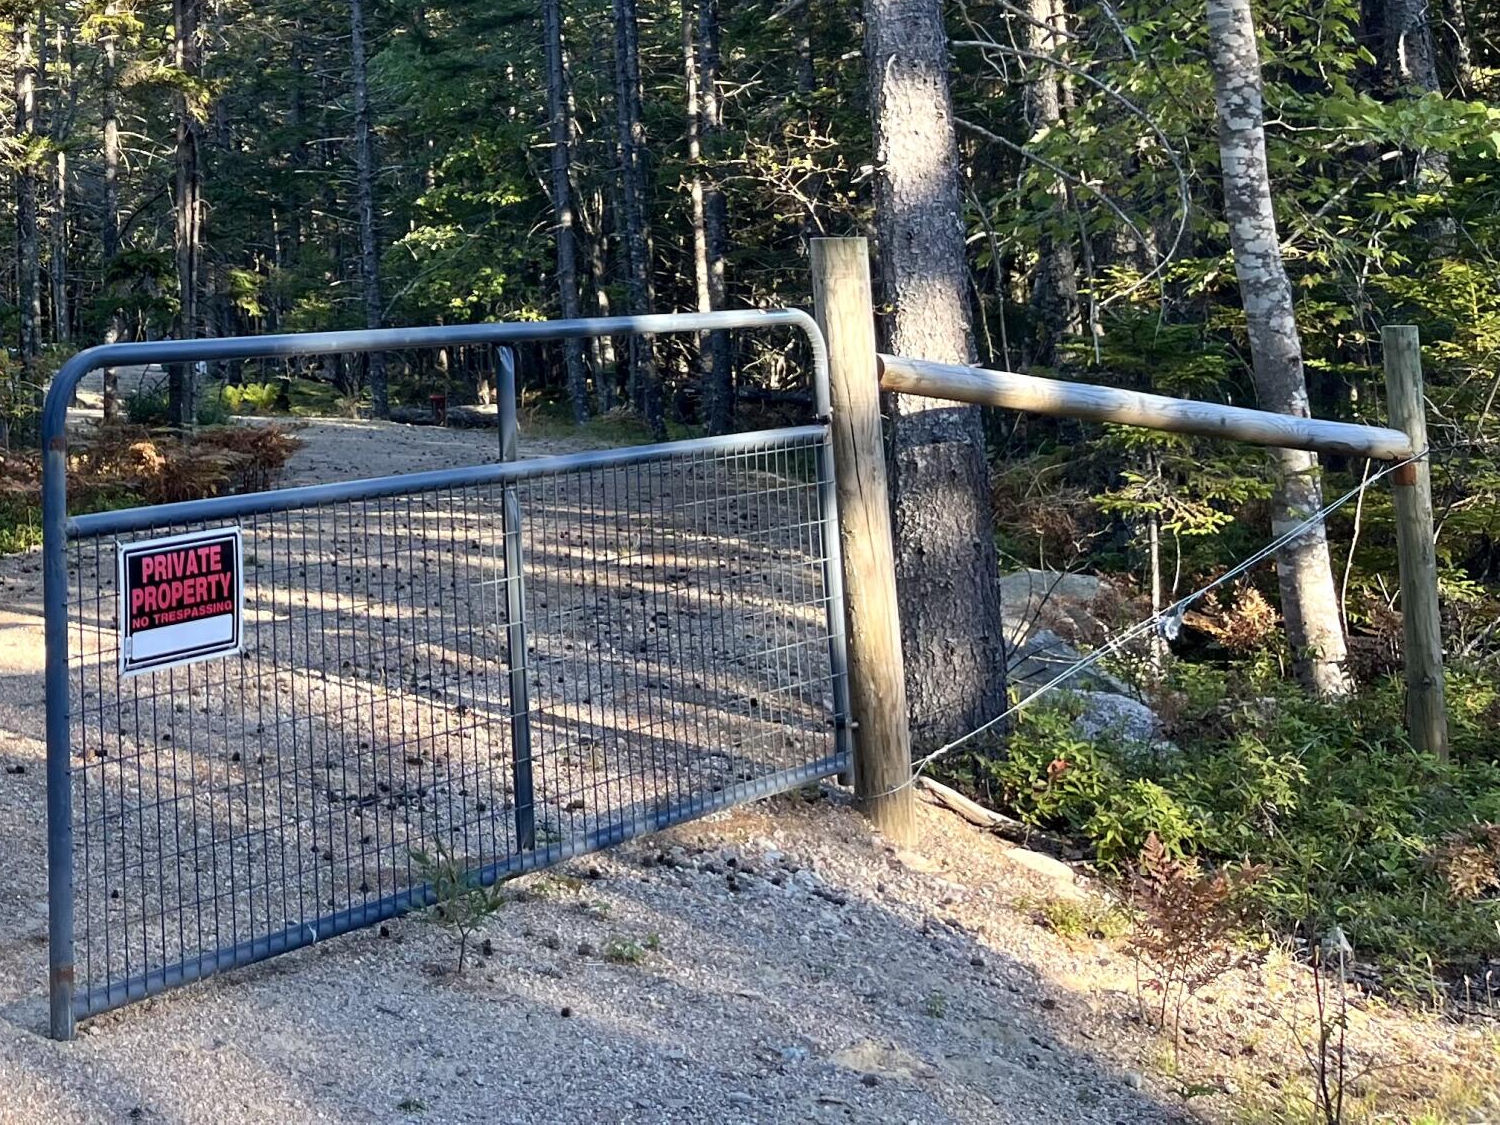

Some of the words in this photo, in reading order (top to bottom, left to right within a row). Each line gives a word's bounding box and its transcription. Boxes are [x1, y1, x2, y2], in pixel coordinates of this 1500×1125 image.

[141, 545, 222, 584] PRIVATE
[131, 571, 232, 615] PROPERTY
[132, 617, 150, 629] NO
[153, 600, 233, 625] TRESPASSING
